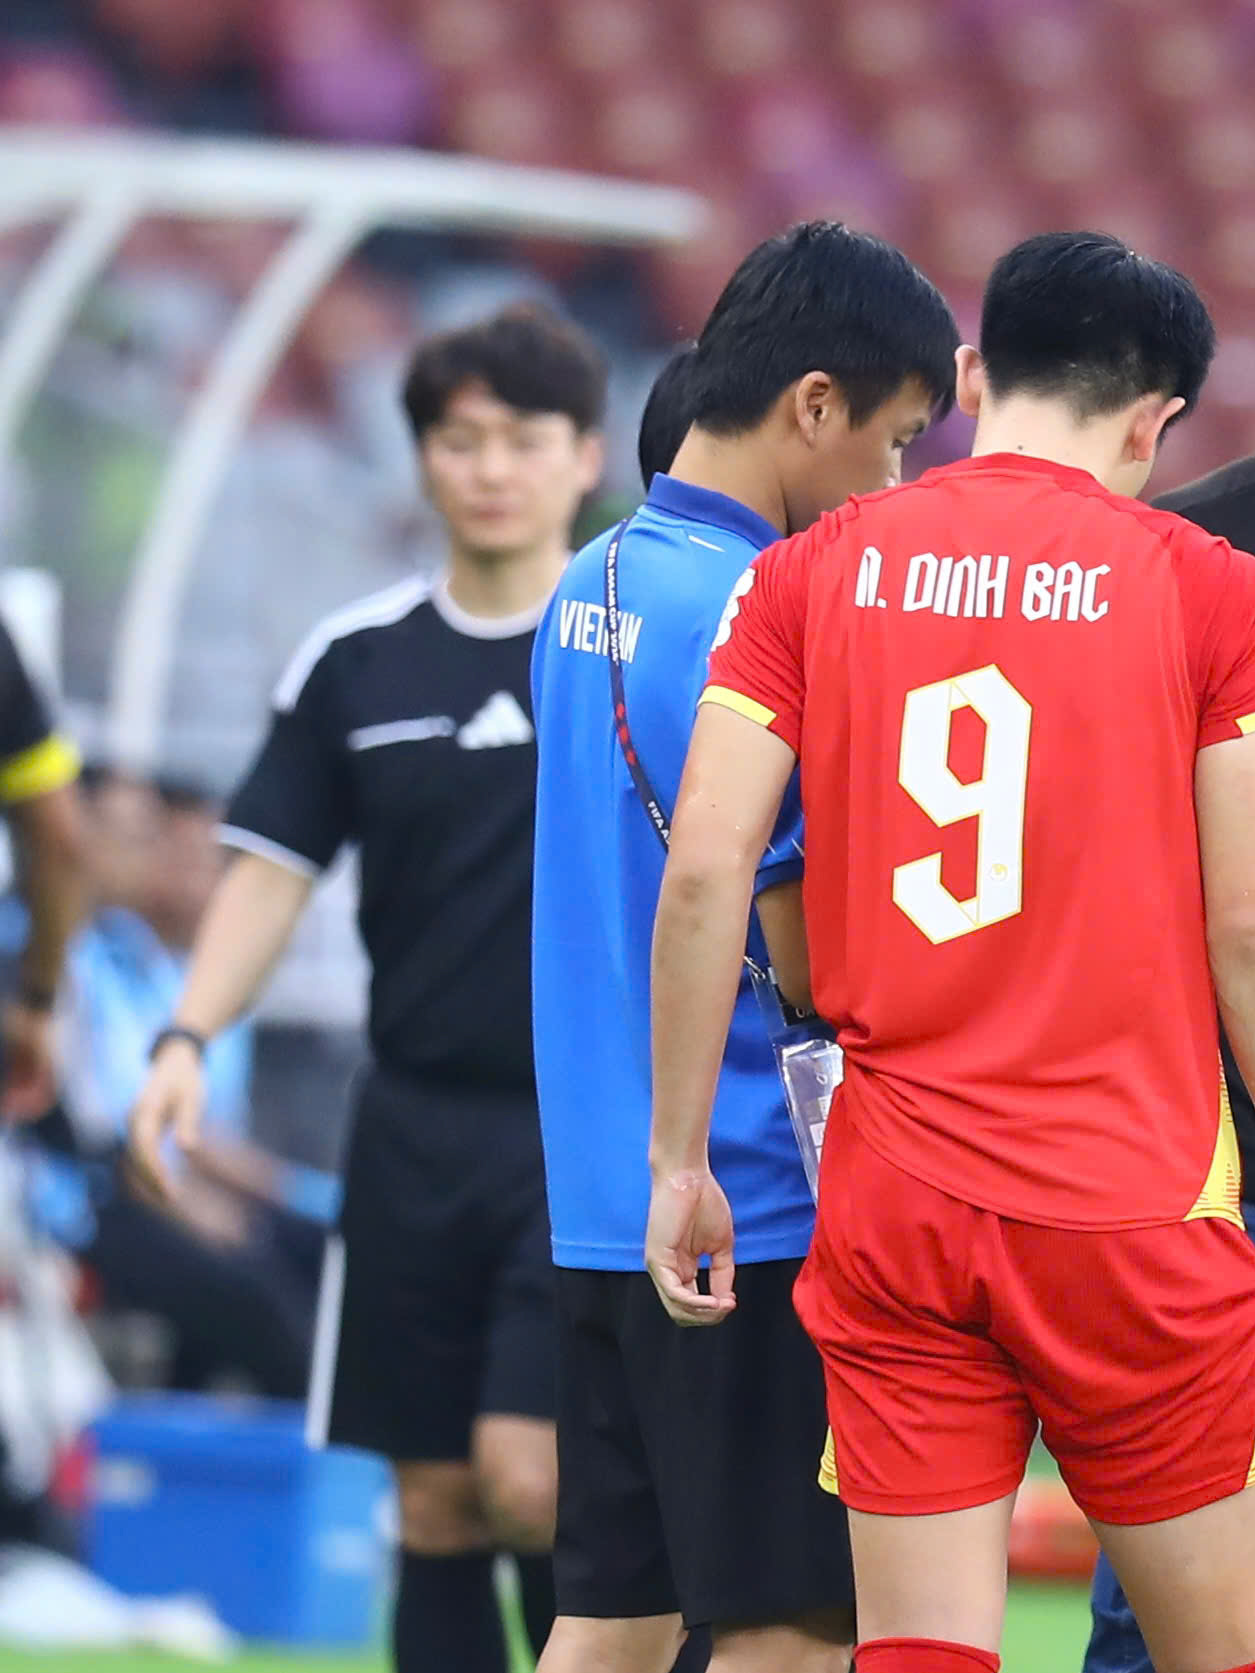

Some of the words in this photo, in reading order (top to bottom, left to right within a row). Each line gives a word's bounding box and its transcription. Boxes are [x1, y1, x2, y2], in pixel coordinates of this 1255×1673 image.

[902, 552, 1010, 619] DINH
[1020, 561, 1111, 623] BAC
[648, 800, 665, 829] FIFA
[892, 663, 1033, 946] 9
